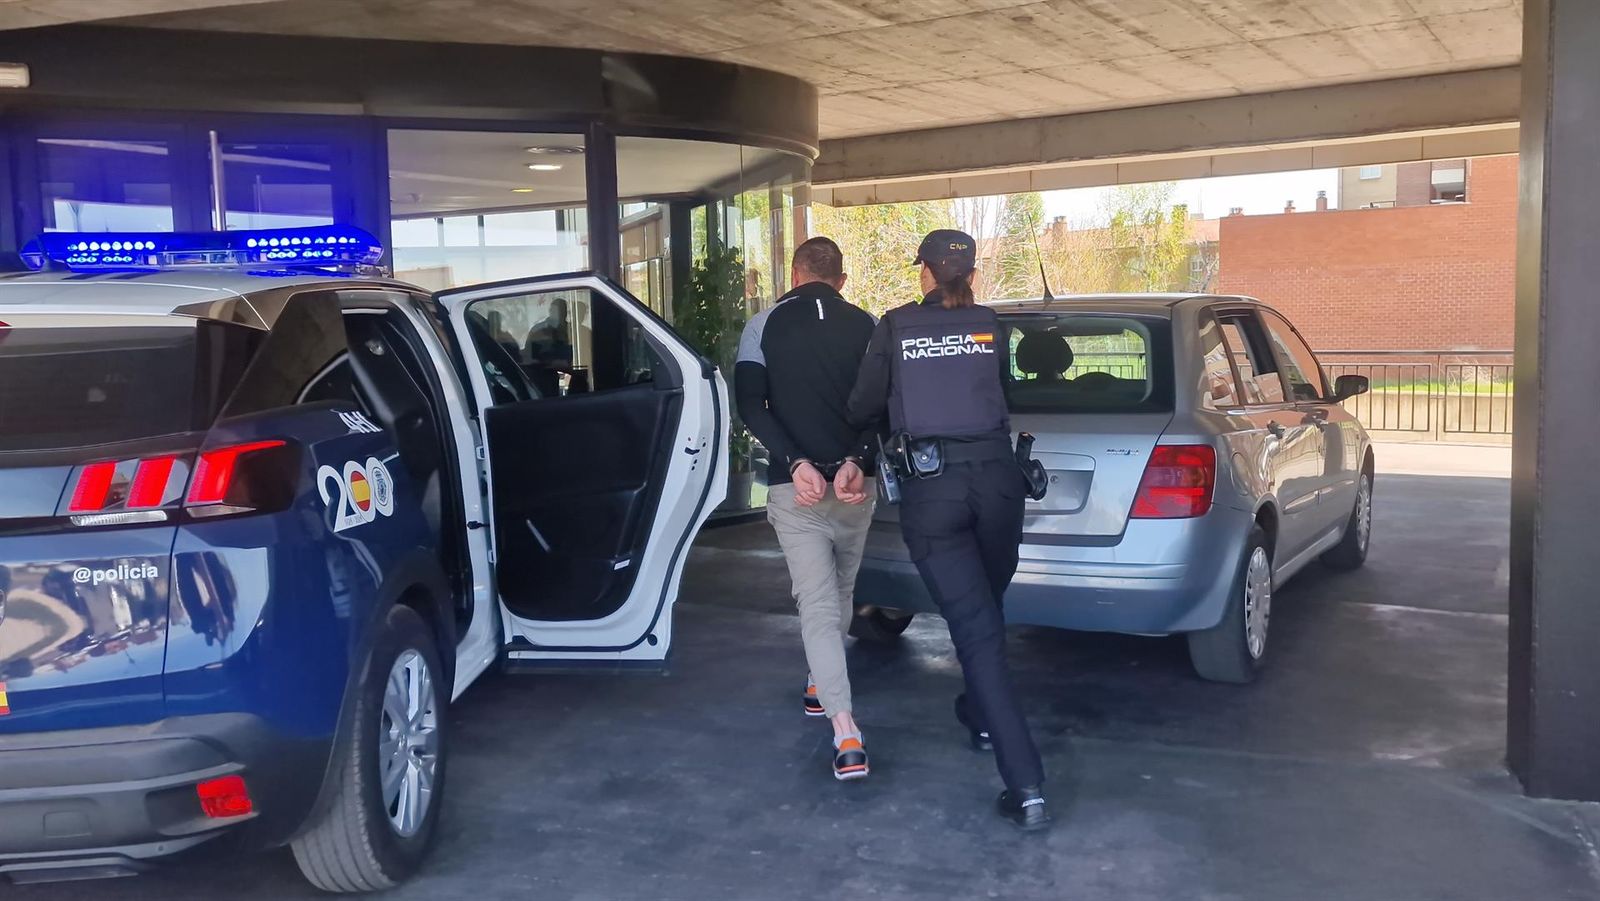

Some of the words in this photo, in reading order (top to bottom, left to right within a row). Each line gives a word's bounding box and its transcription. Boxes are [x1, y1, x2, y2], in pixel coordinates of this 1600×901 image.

[901, 334, 975, 350] POLICIA
[902, 343, 994, 360] NACIONAL
[316, 456, 394, 533] 200
[73, 563, 159, 586] @policia
